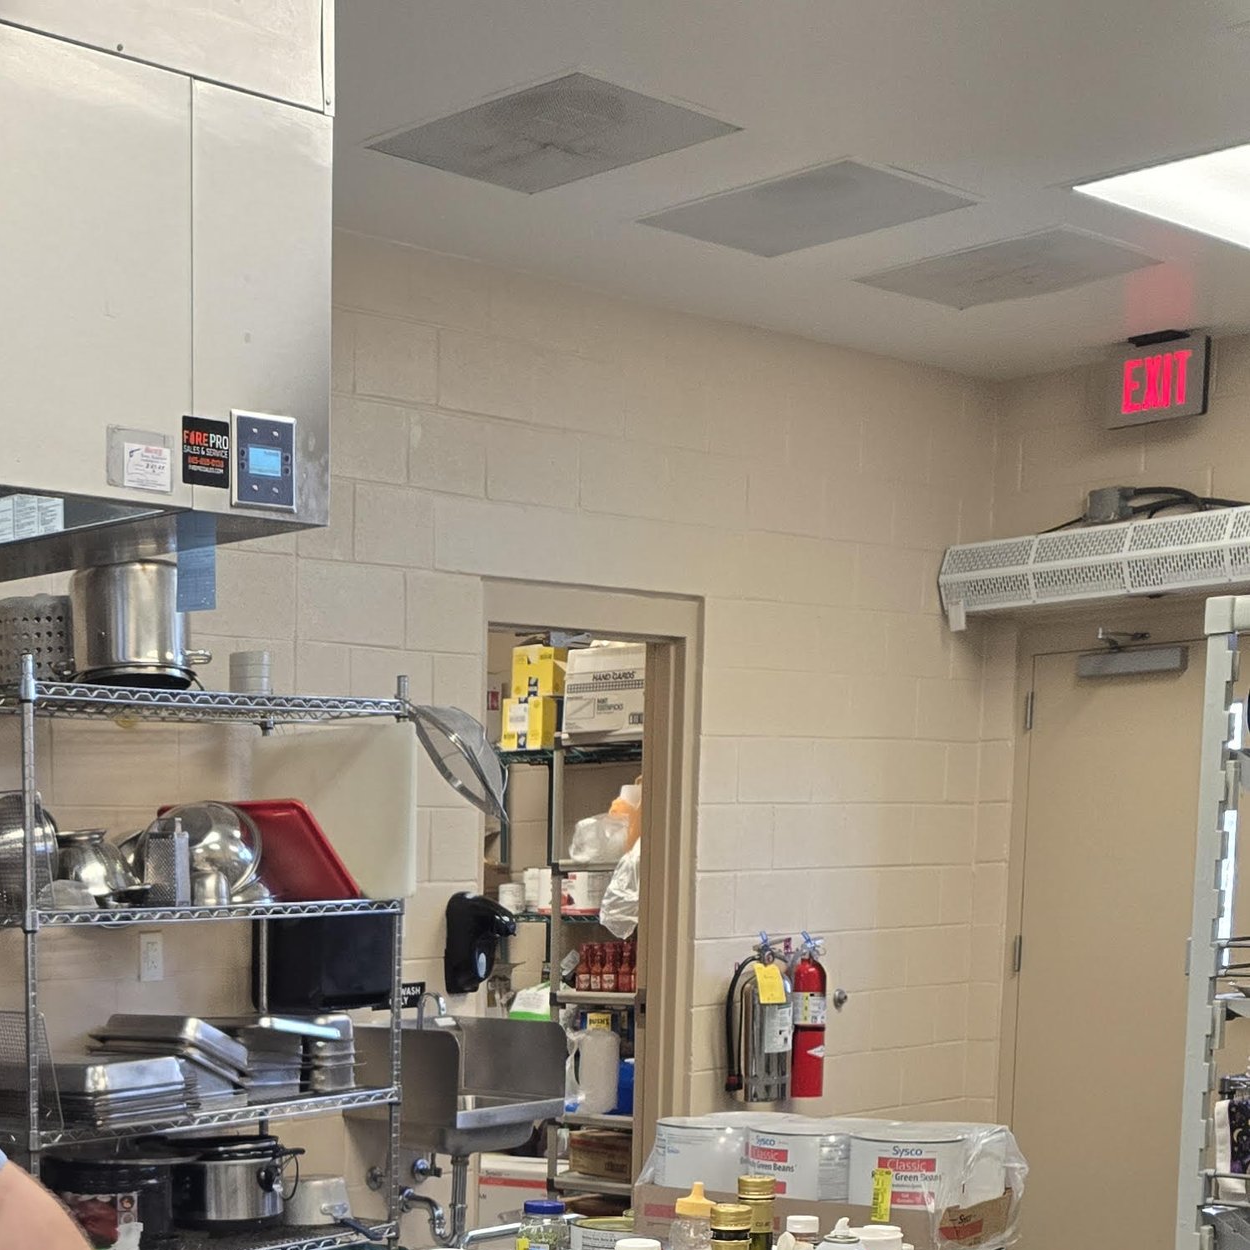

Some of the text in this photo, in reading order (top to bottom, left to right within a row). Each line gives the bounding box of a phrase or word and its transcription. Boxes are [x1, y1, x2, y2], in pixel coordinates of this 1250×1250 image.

[1121, 349, 1193, 414] EXIT
[209, 433, 229, 450] PRO
[183, 444, 200, 455] SALES
[206, 447, 228, 459] SERVICE
[756, 1135, 776, 1147] Sysco
[892, 1146, 923, 1158] Sysco
[773, 1162, 794, 1173] Beans
[887, 1158, 927, 1172] Classic
[895, 1173, 919, 1182] Green
